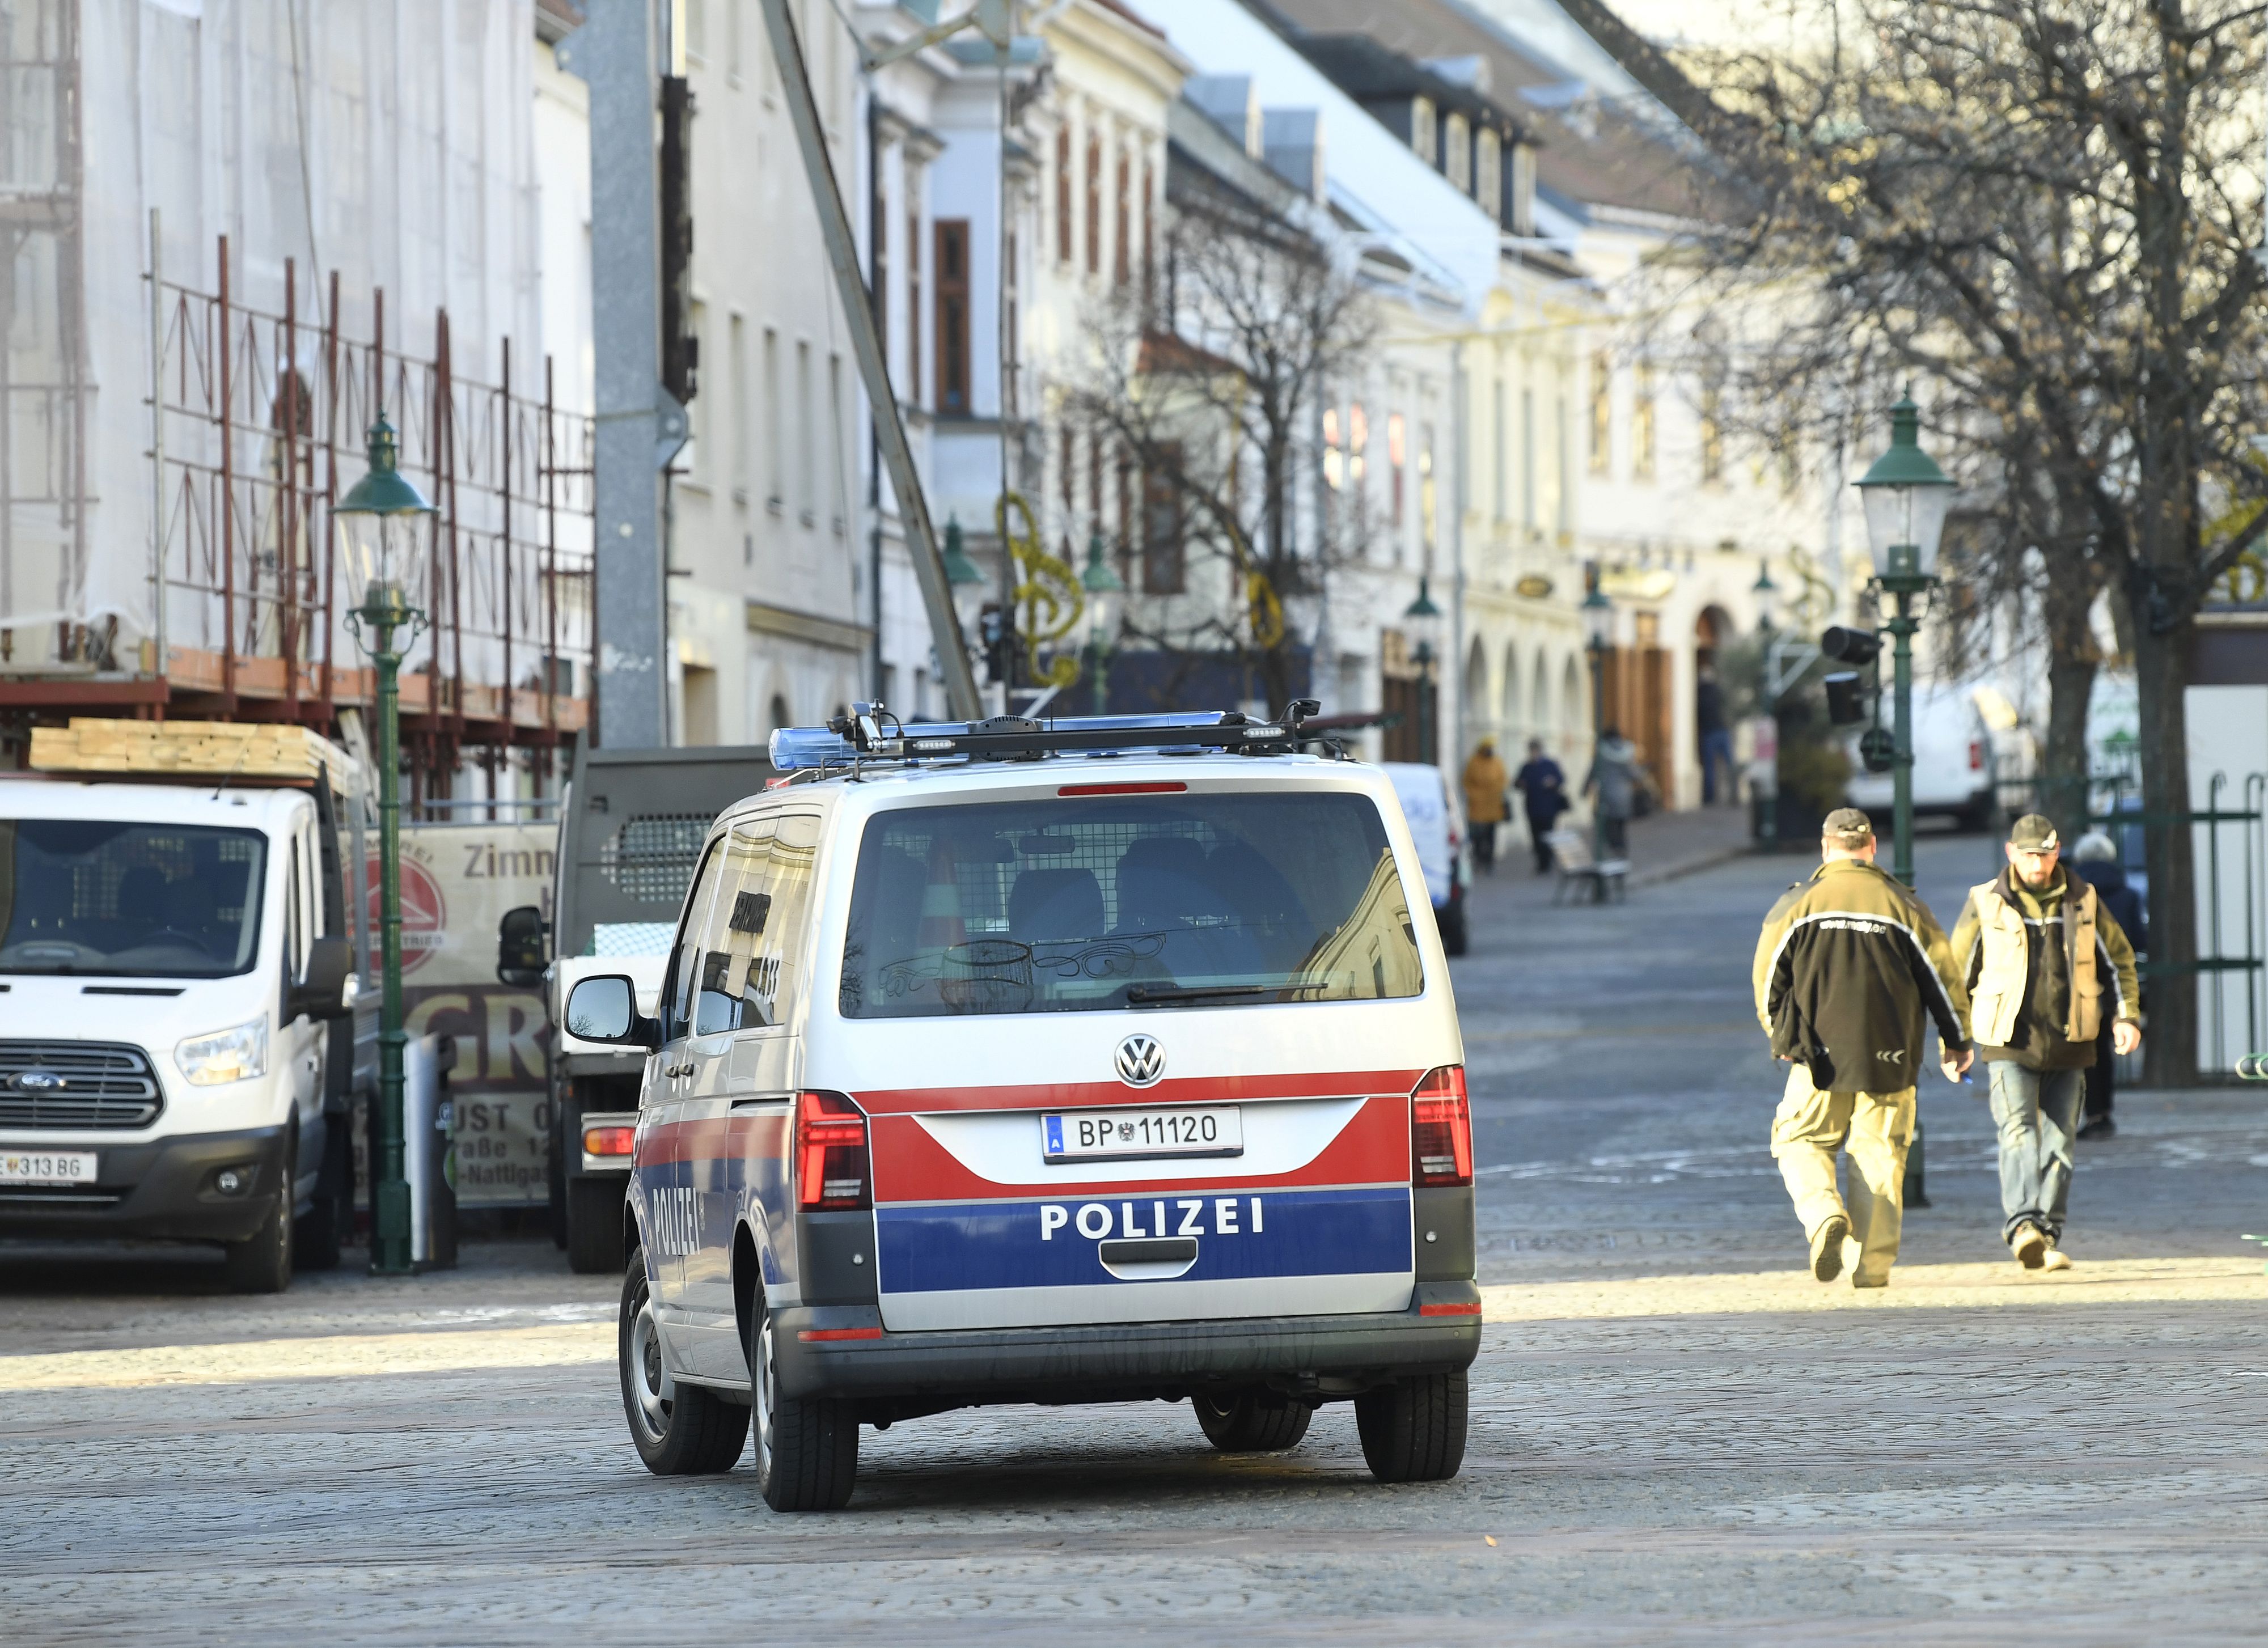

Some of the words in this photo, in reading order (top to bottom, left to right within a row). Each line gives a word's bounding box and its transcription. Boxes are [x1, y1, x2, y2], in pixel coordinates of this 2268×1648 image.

[1051, 1139, 1061, 1149] A
[1079, 1120, 1113, 1147] BP
[1139, 1115, 1217, 1145] 11120
[20, 1157, 52, 1175] 313
[57, 1158, 80, 1176] BG
[653, 1187, 700, 1256] POLIZEI
[1040, 1197, 1263, 1240] POLIZEI
